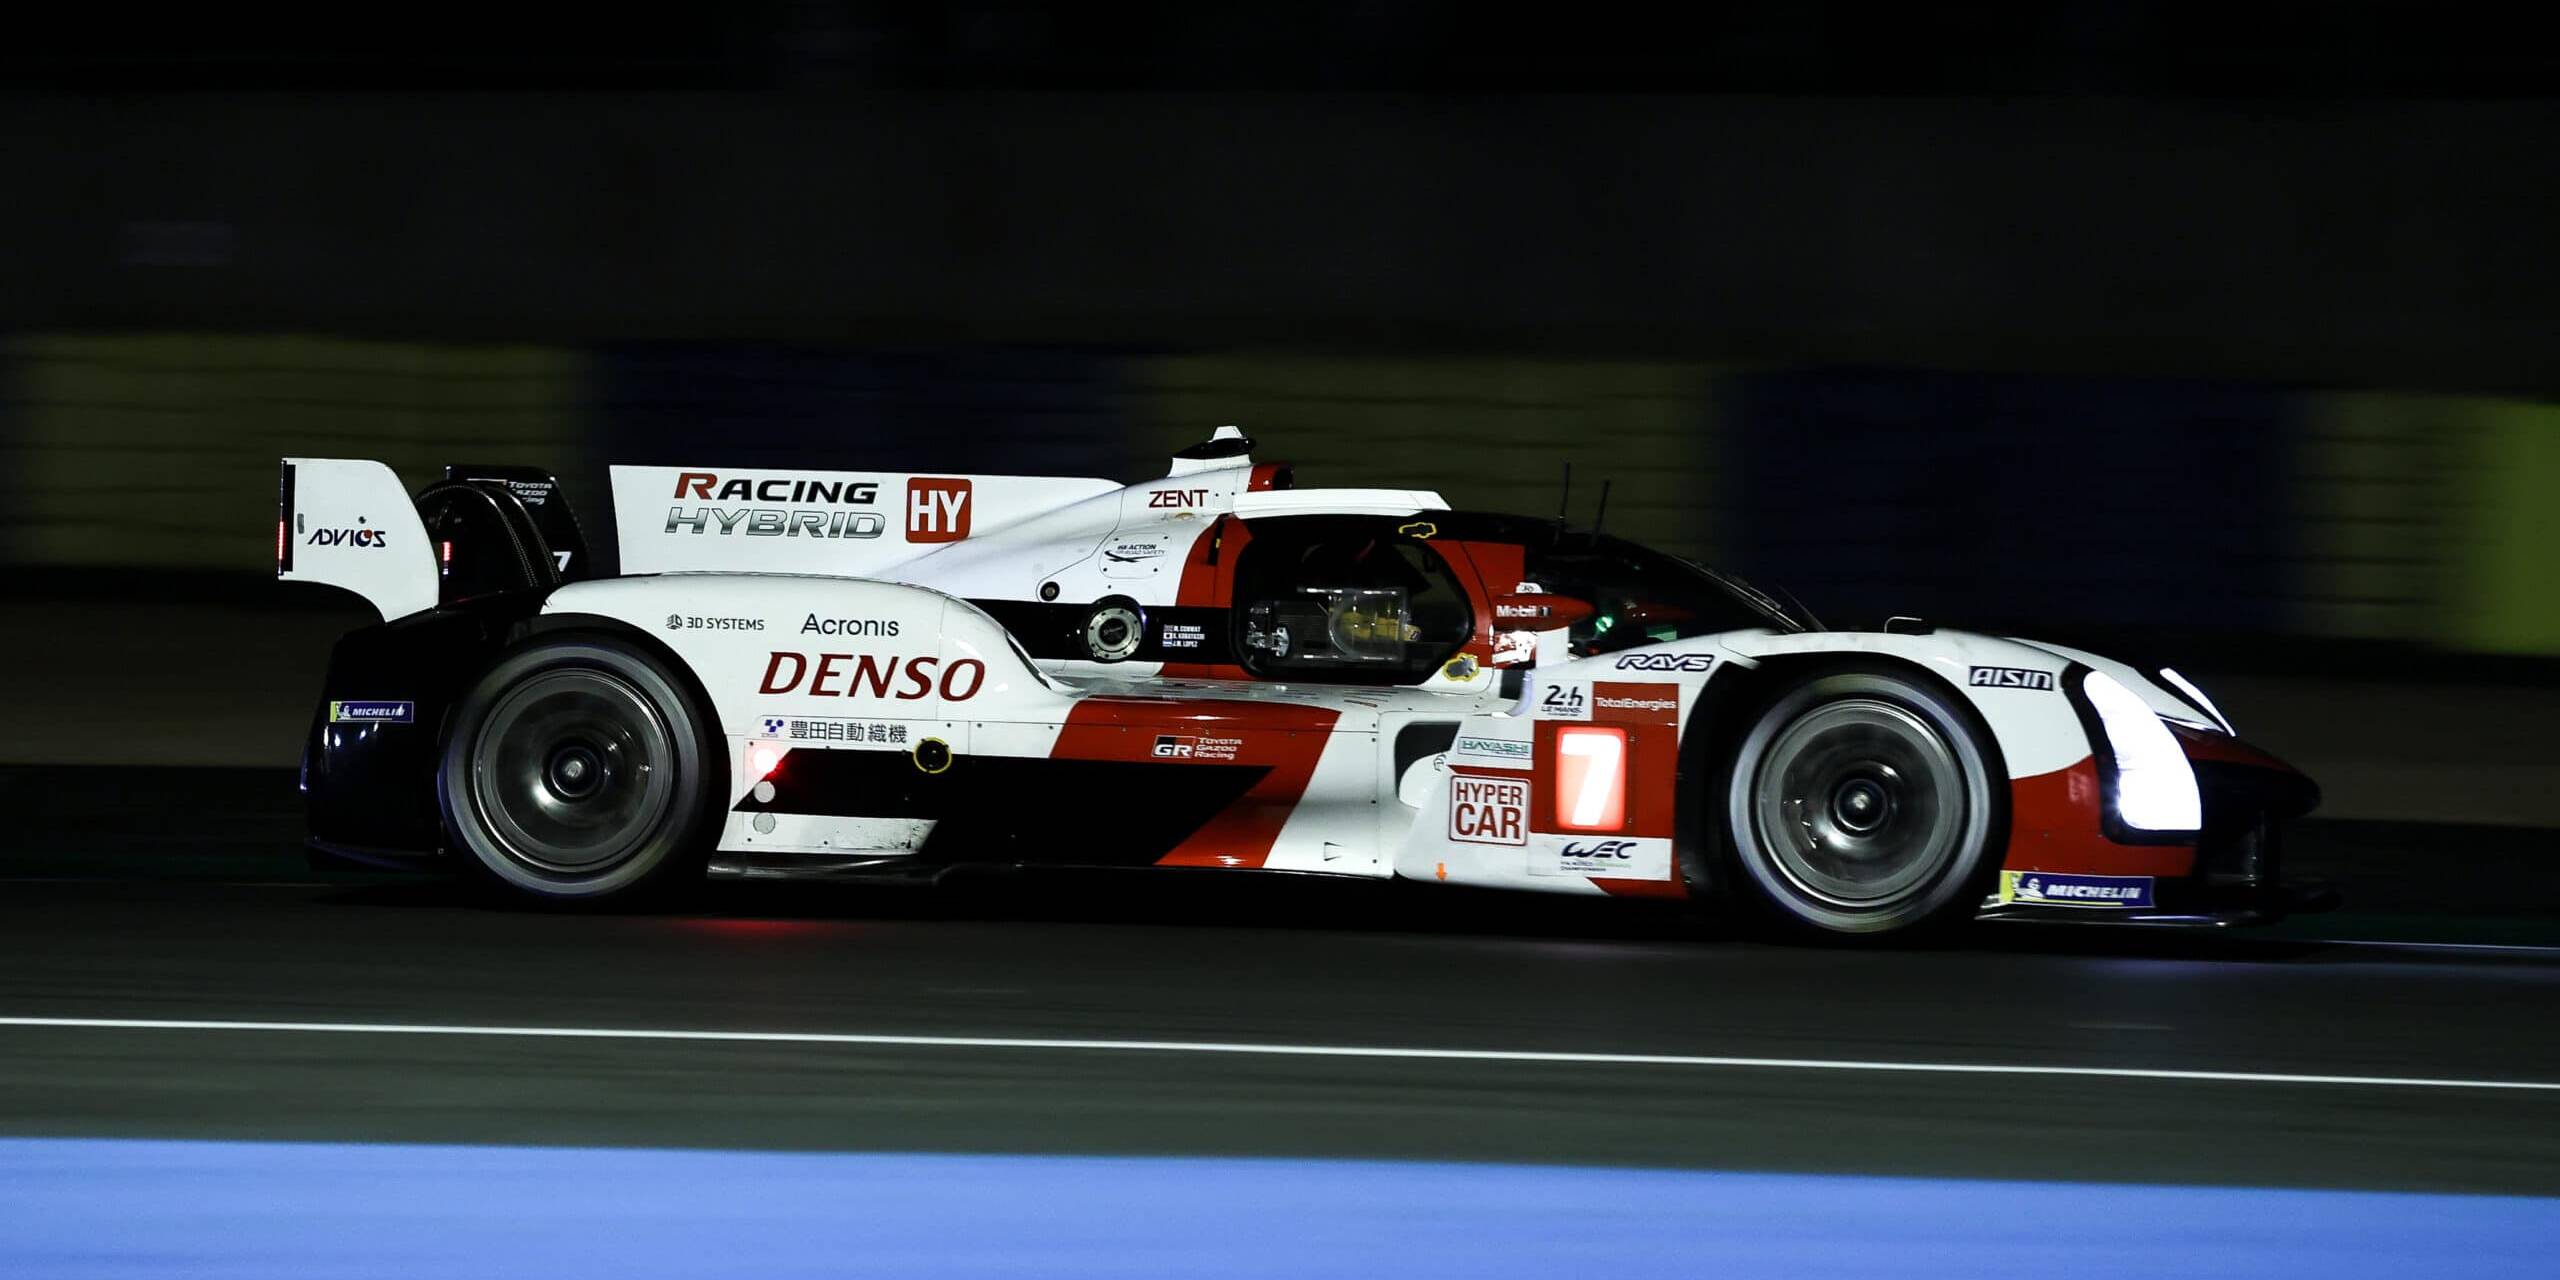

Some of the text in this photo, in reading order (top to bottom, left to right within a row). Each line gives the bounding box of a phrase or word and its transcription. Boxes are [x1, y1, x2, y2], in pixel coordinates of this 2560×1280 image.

[674, 473, 879, 504] RACING
[1149, 490, 1209, 508] ZENT
[910, 489, 968, 532] HY
[664, 507, 886, 539] HYBRID
[307, 529, 386, 548] ADVICS
[553, 551, 572, 572] 7
[687, 617, 765, 631] 3D SYSTEMS
[800, 613, 899, 636] Acronis
[1616, 653, 1715, 671] RAYS
[758, 652, 986, 702] DENSO
[1971, 667, 2053, 690] AISIN
[1543, 685, 1584, 706] 24h
[1595, 697, 1677, 711] TotalEnergies
[352, 706, 405, 716] MICHELIN
[1154, 743, 1193, 757] GR
[1199, 737, 1242, 745] TOYOTA
[1561, 734, 1622, 826] 7
[1456, 782, 1522, 806] HYPER
[1455, 803, 1521, 839] CAR
[1561, 841, 1638, 860] WEC
[2046, 884, 2141, 899] MICHELIN
